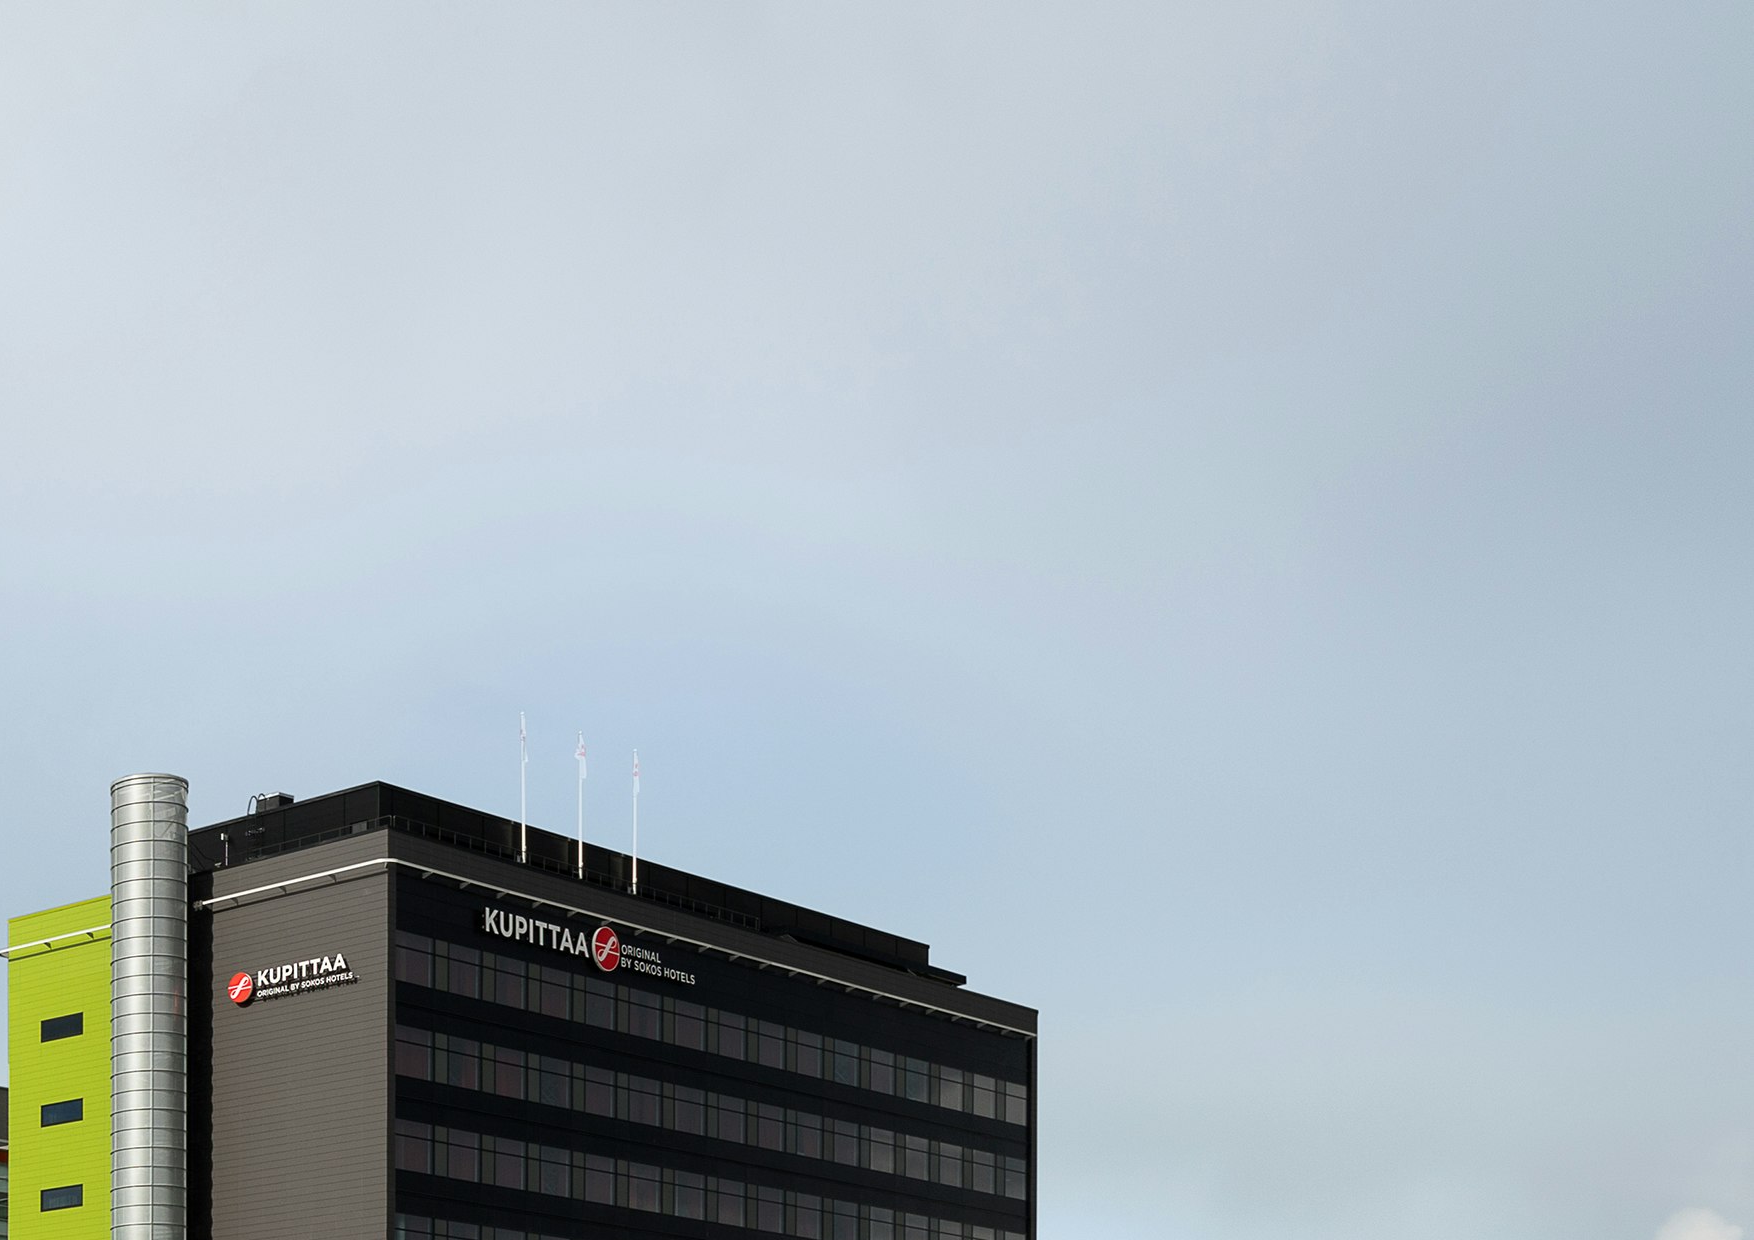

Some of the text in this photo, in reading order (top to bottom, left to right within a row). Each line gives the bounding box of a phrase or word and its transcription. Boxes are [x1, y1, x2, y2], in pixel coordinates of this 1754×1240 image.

[484, 906, 590, 959] KUPITTAA
[621, 944, 661, 964] ORIGINAL
[257, 953, 347, 987] KUPITTAA
[621, 957, 696, 985] BY SOKOS HOTELS
[256, 972, 354, 998] ORIGINAL BY SOKOS HOTELS
